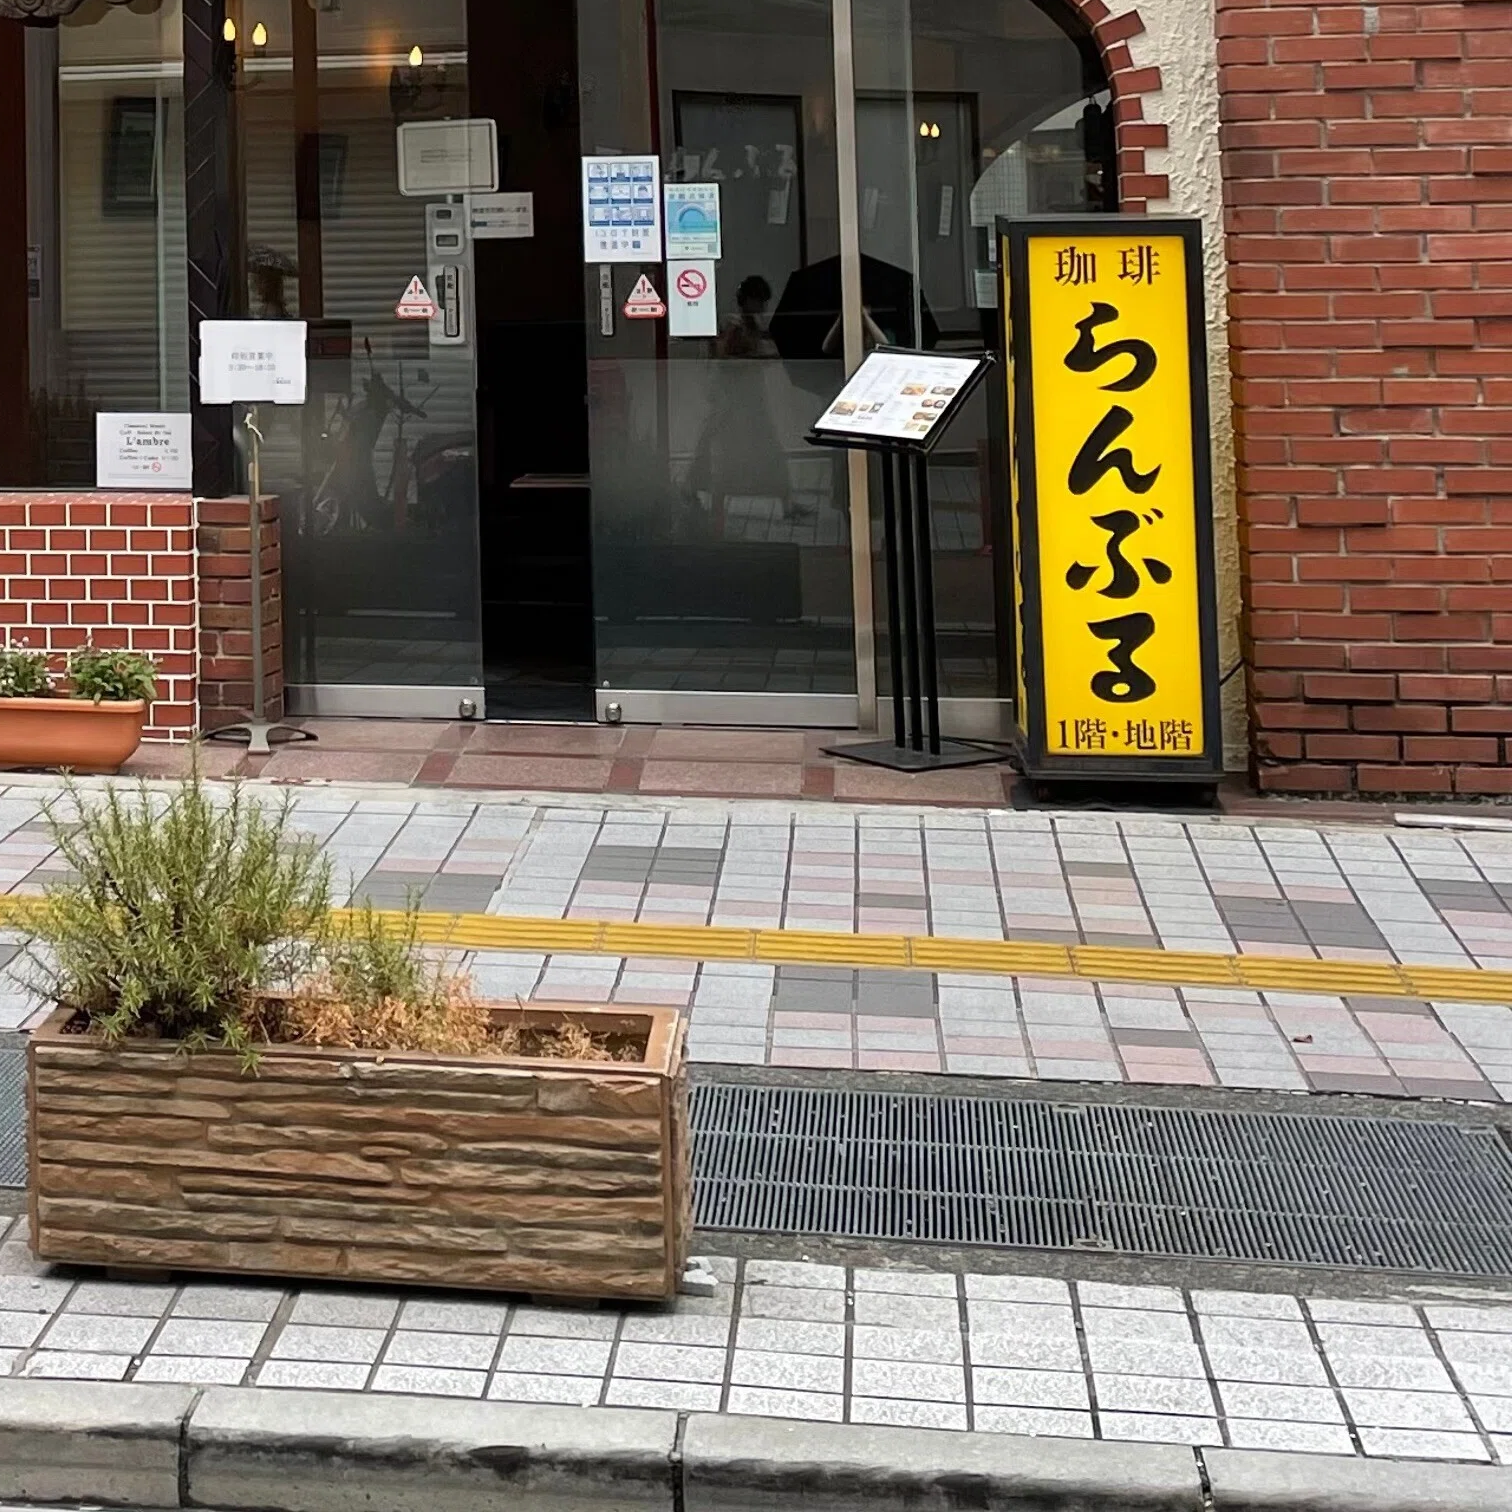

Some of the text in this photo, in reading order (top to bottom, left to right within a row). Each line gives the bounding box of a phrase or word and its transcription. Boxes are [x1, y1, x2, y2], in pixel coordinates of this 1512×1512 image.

[1054, 245, 1161, 286] 珈琲
[126, 436, 170, 446] L'ambre
[1063, 301, 1172, 703] らんぶる
